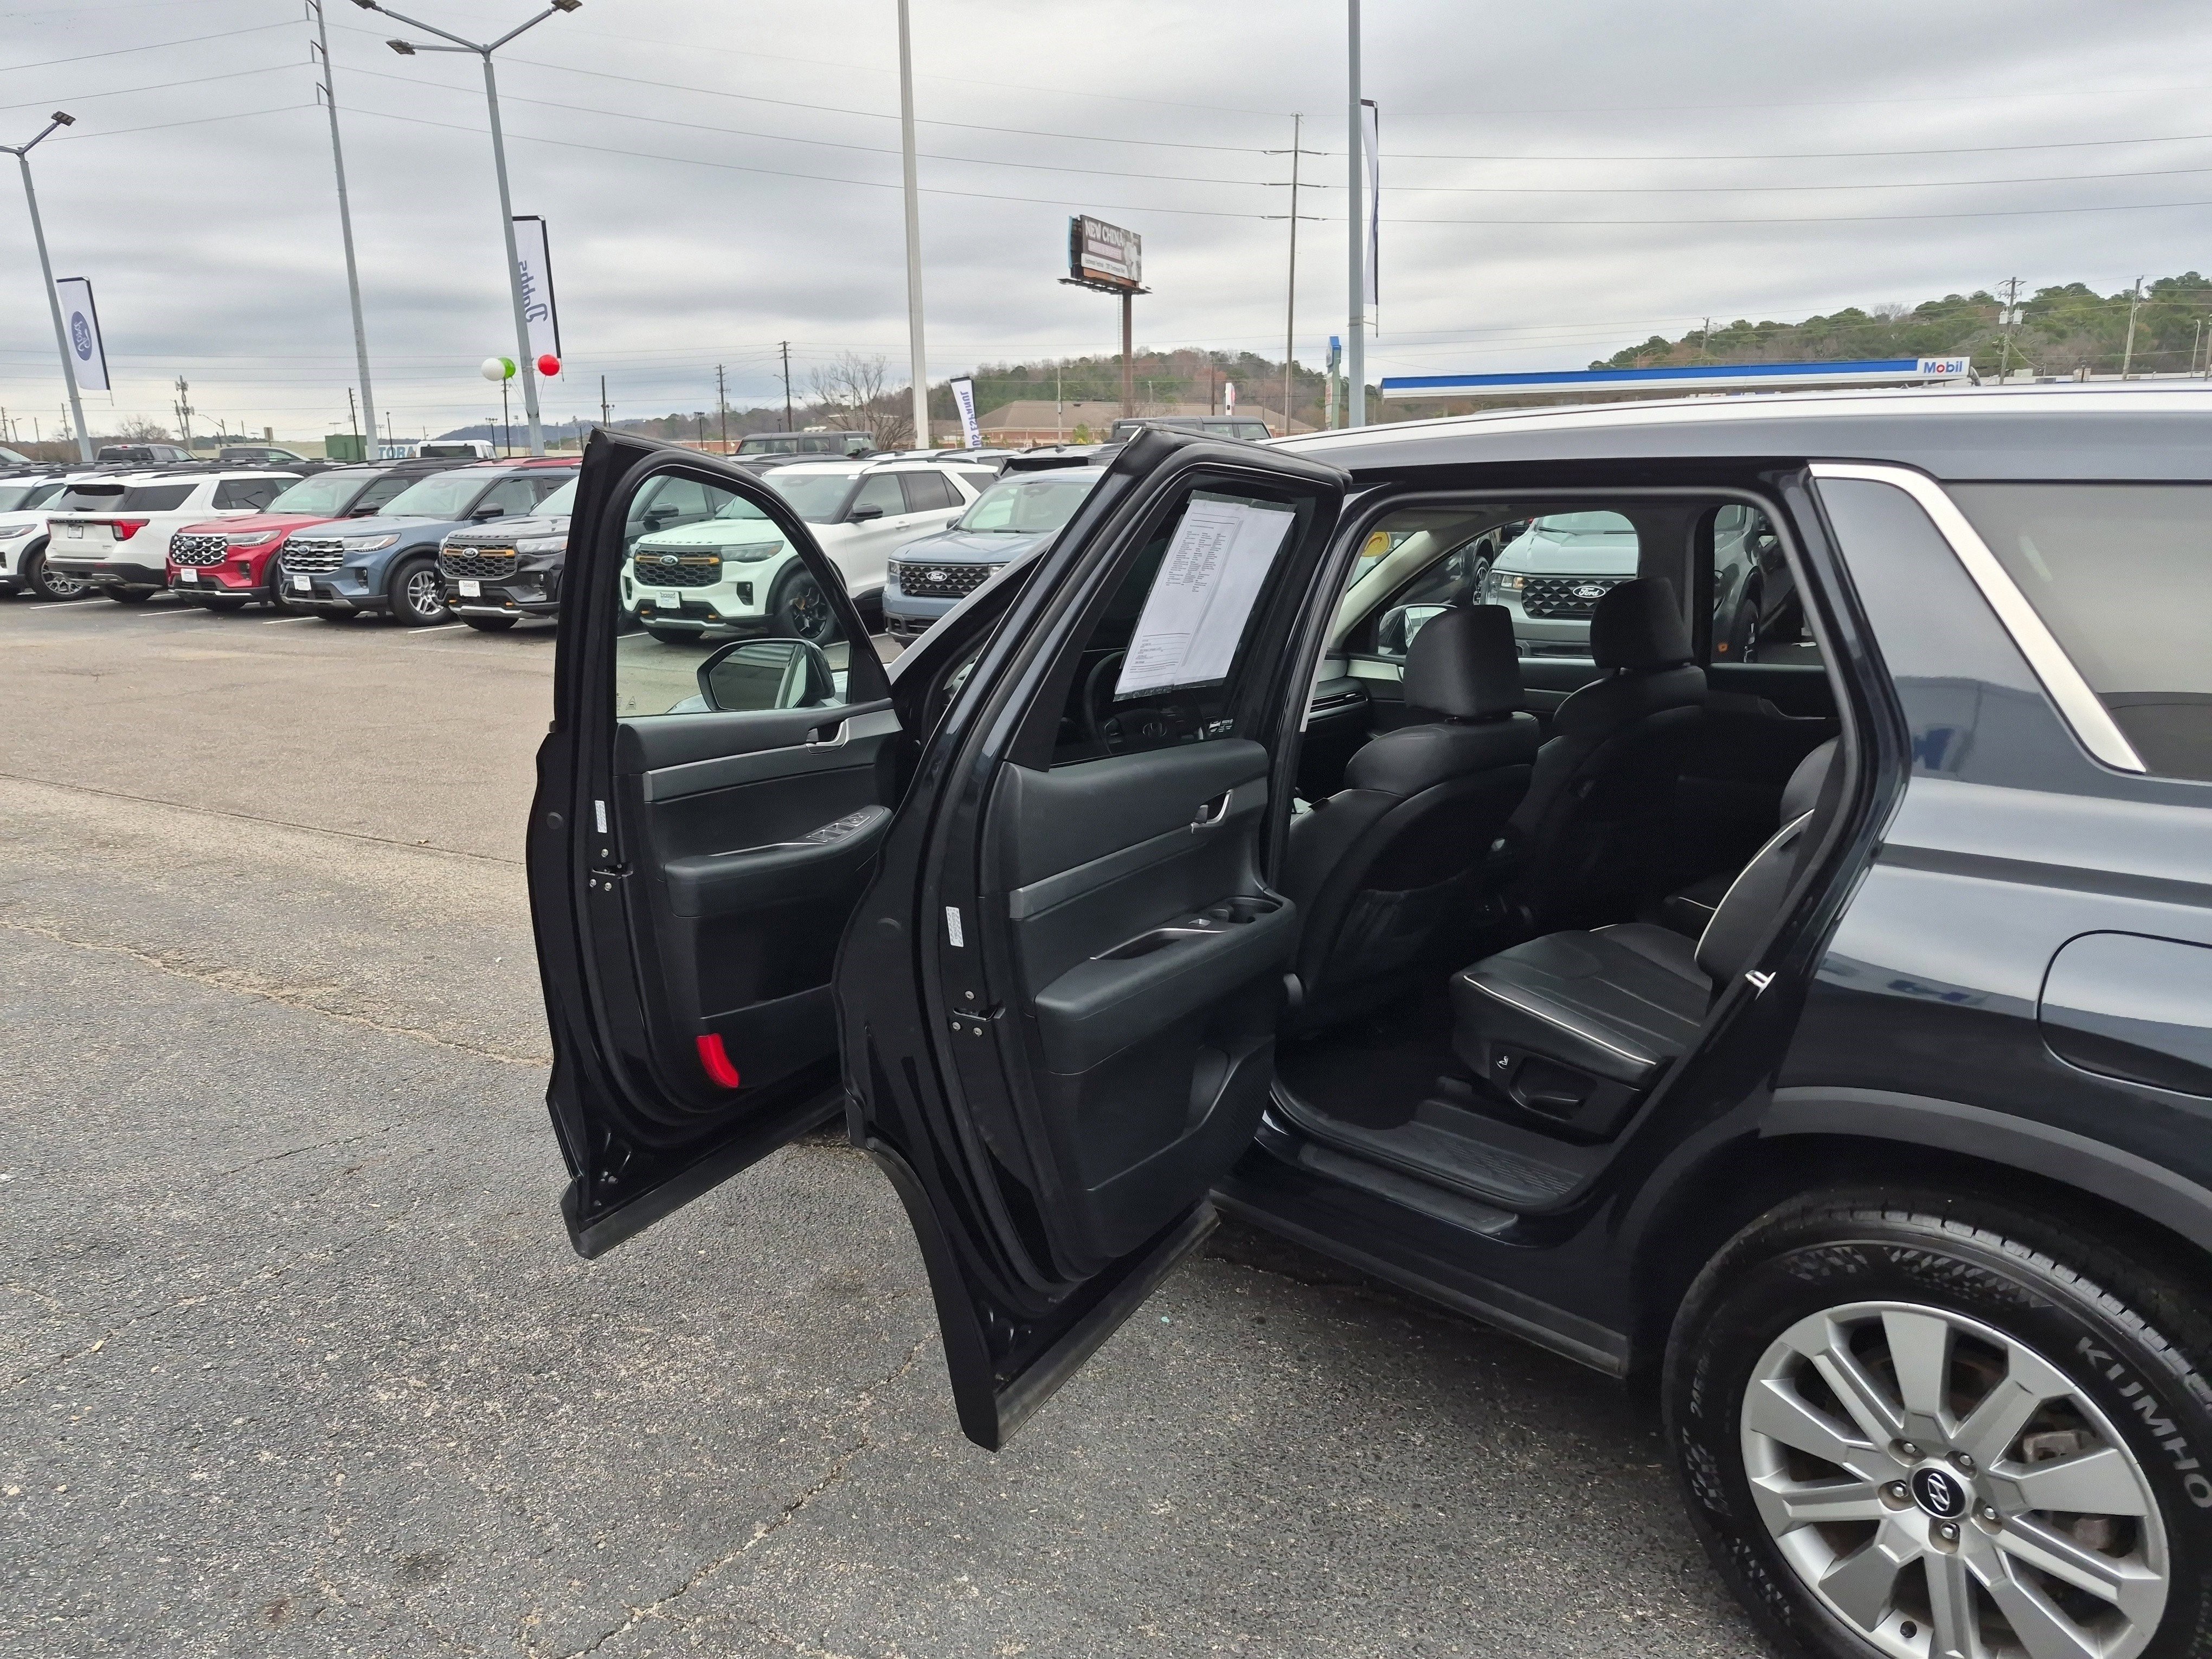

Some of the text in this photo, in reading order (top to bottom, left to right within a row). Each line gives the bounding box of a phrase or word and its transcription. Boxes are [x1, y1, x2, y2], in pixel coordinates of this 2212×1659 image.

[1085, 220, 1124, 248] NEW CHINA
[1924, 361, 1963, 373] Mobil
[378, 446, 416, 459] TORA
[1578, 587, 1600, 596] Ford
[2076, 1336, 2212, 1508] KUMHO
